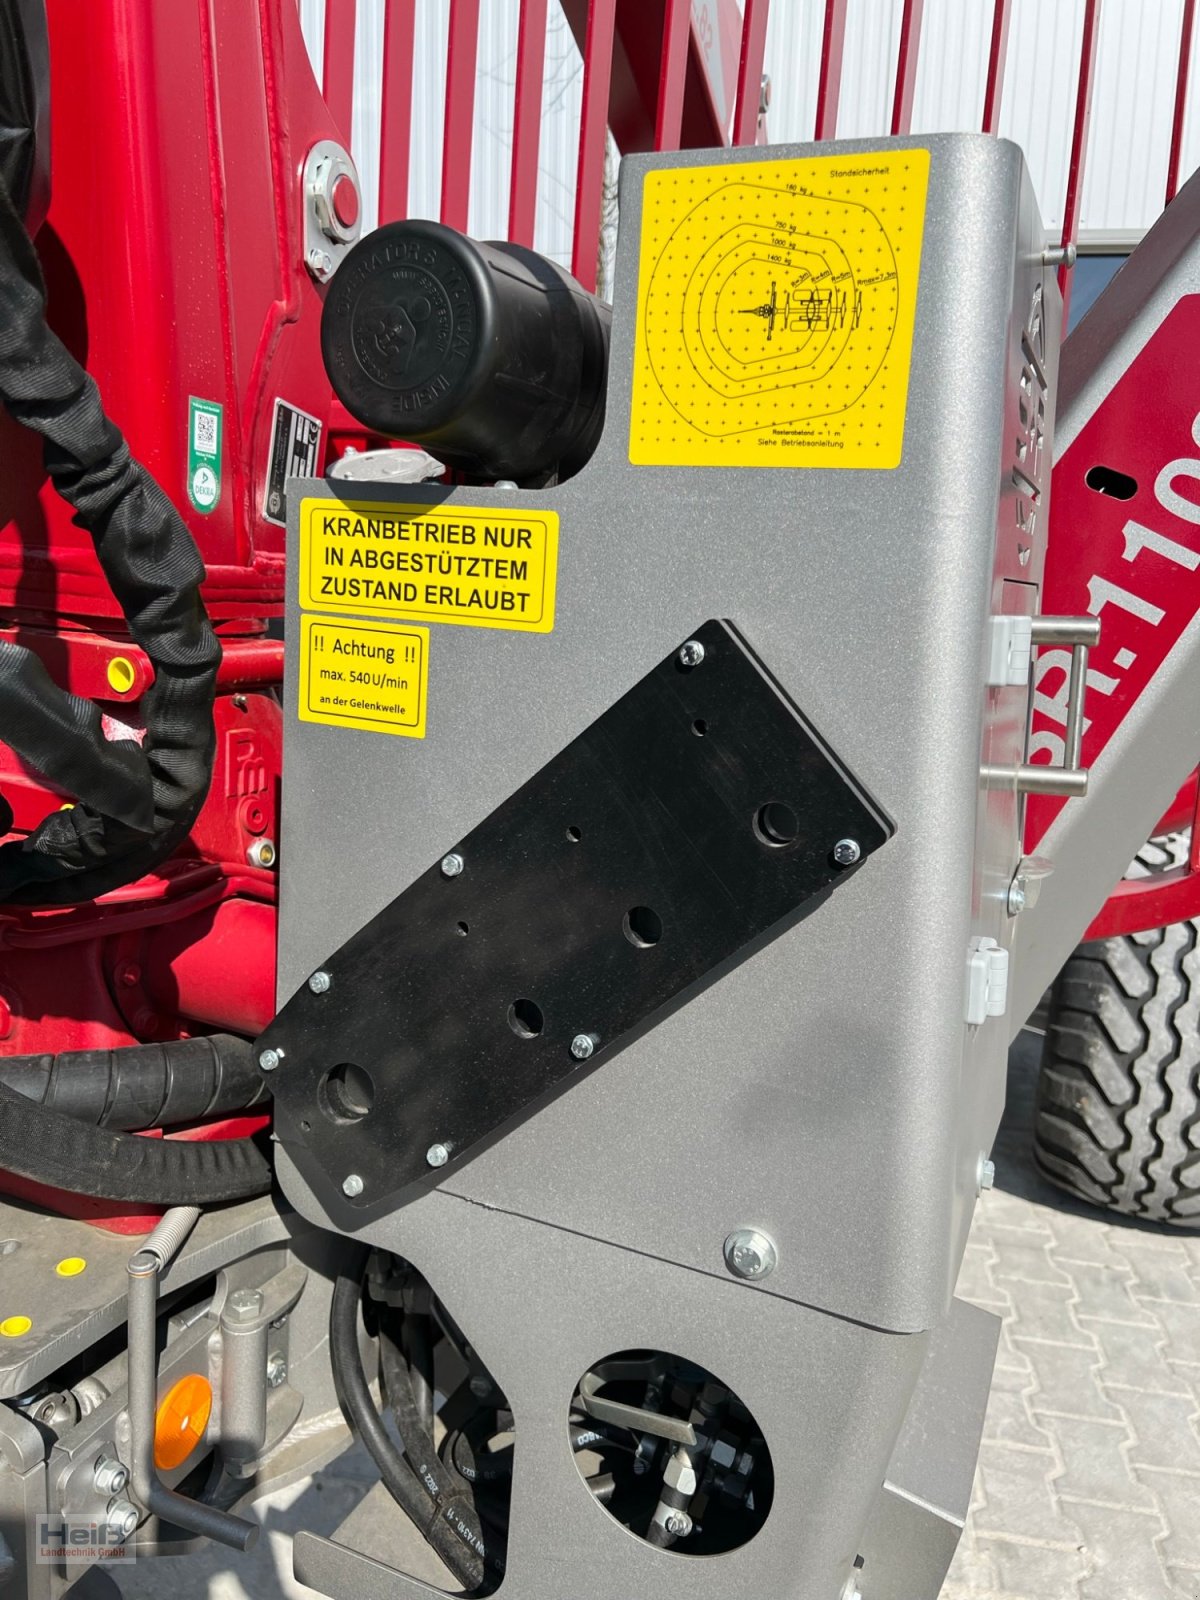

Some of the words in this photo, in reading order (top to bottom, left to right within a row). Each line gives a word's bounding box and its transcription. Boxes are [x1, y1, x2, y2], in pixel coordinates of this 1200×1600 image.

[830, 167, 890, 178] Standsicherheit
[776, 221, 787, 229] 750
[772, 238, 786, 247] 1000
[768, 254, 781, 263] 1400
[758, 438, 777, 446] Siehe
[781, 438, 844, 449] Betriebsanleitung
[323, 517, 476, 545] KRANBETRIEB
[484, 527, 532, 549] NUR
[325, 547, 343, 566] IN
[350, 549, 528, 581] ABGESTÜTZTEM
[321, 576, 418, 602] ZUSTAND
[425, 585, 530, 612] ERLAUBT
[314, 635, 324, 652] !!
[332, 638, 395, 664] Achtung
[405, 646, 415, 663] !!
[320, 669, 346, 682] max.
[349, 671, 371, 685] 540
[372, 673, 408, 690] U/min
[320, 696, 331, 704] an
[332, 696, 348, 706] der
[349, 698, 406, 715] Gelenkwelle
